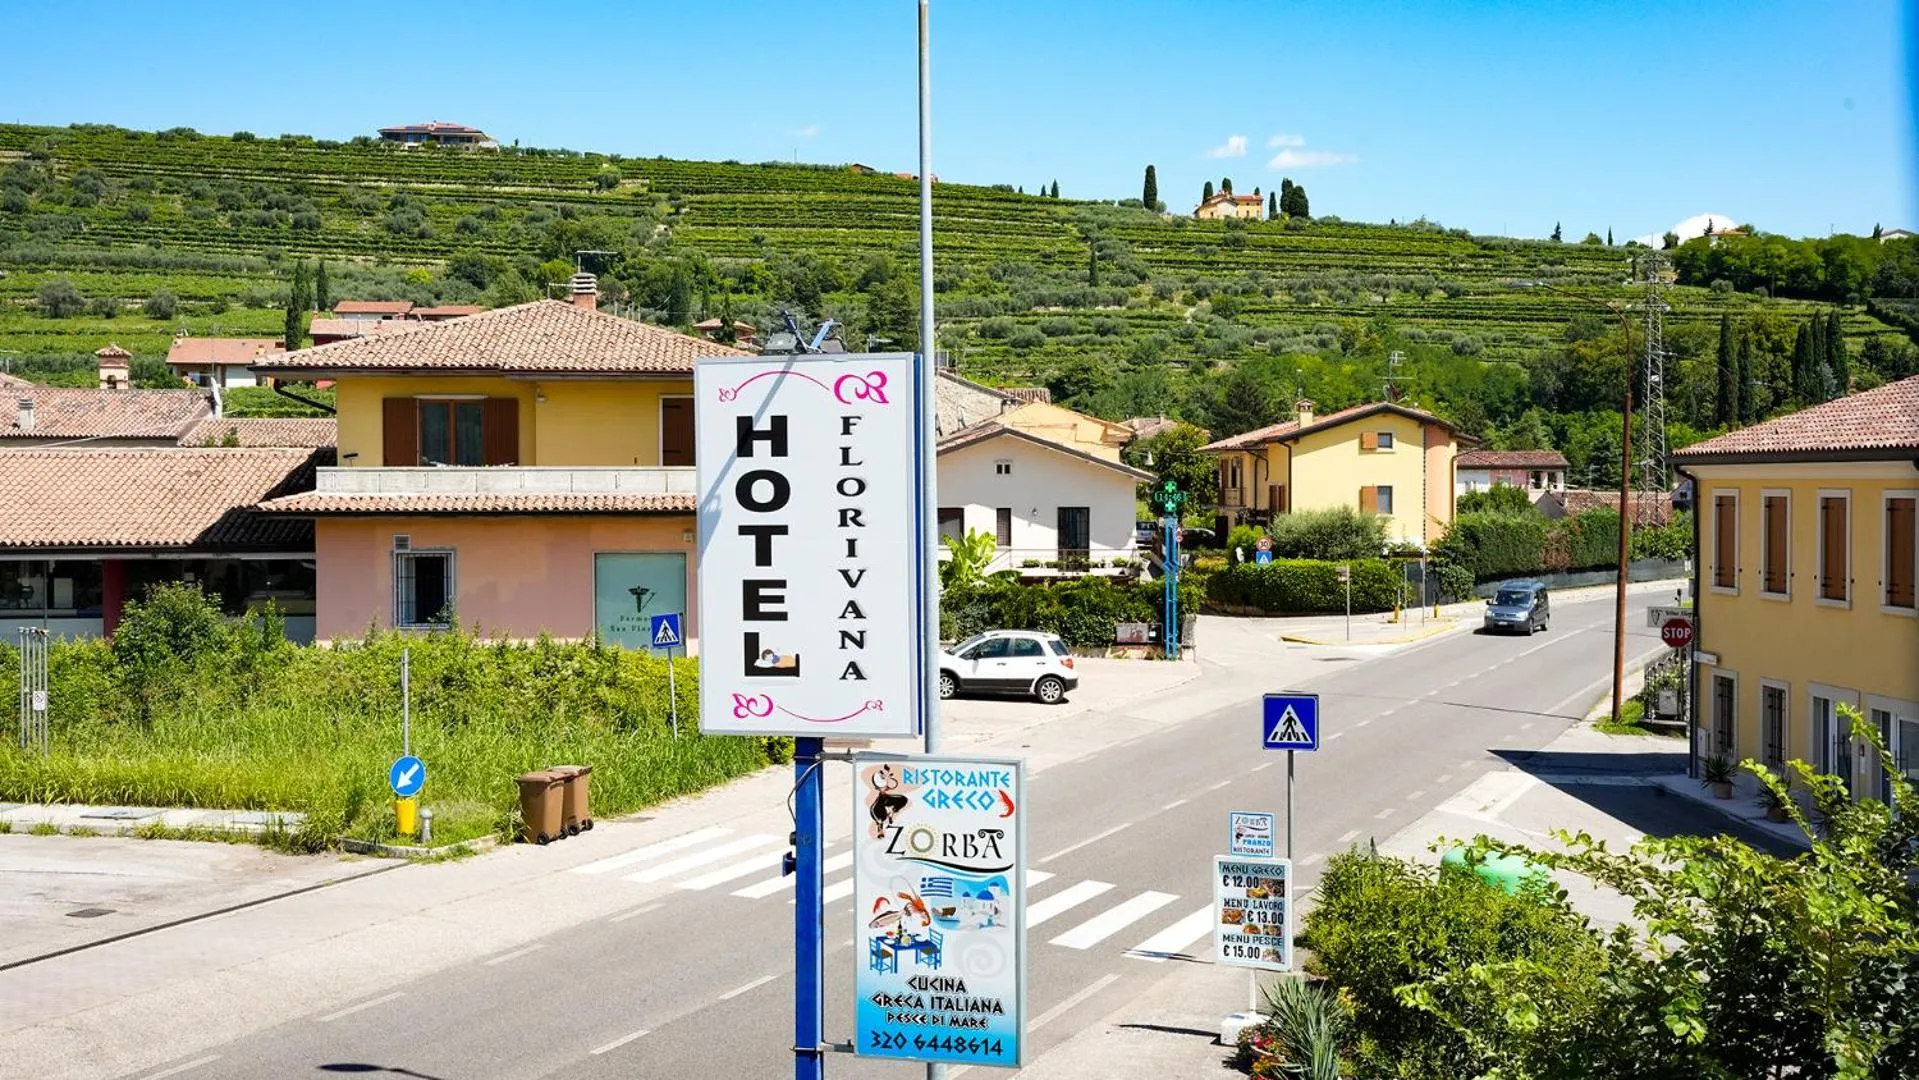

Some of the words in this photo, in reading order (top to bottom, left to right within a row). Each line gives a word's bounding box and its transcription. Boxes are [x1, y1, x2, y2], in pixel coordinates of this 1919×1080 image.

[735, 415, 800, 678] HOTEL
[836, 415, 867, 680] FLORIVANA
[1663, 627, 1691, 639] STOP
[902, 768, 1010, 788] RISTORANTE
[922, 788, 995, 811] GRECO
[884, 823, 1005, 859] ZORBA
[1222, 864, 1249, 874] MENU
[1251, 866, 1283, 876] GRECO
[1223, 875, 1230, 887] €
[1232, 875, 1260, 888] 12.00
[1223, 898, 1249, 908] MENU
[1247, 910, 1254, 922] €
[1257, 911, 1284, 925] 13.00
[1222, 934, 1250, 943] MENU
[1252, 936, 1283, 946] PESCE
[1223, 945, 1230, 957] €
[1232, 945, 1260, 959] 15.00
[908, 975, 967, 993] CUCINA
[872, 992, 924, 1009] GRECA
[930, 996, 1004, 1014] ITALIANA
[887, 1012, 927, 1024] PESCE
[932, 1014, 944, 1026] DI
[949, 1016, 988, 1029] MARE
[871, 1031, 908, 1050] 320
[913, 1033, 1003, 1056] 6448614
